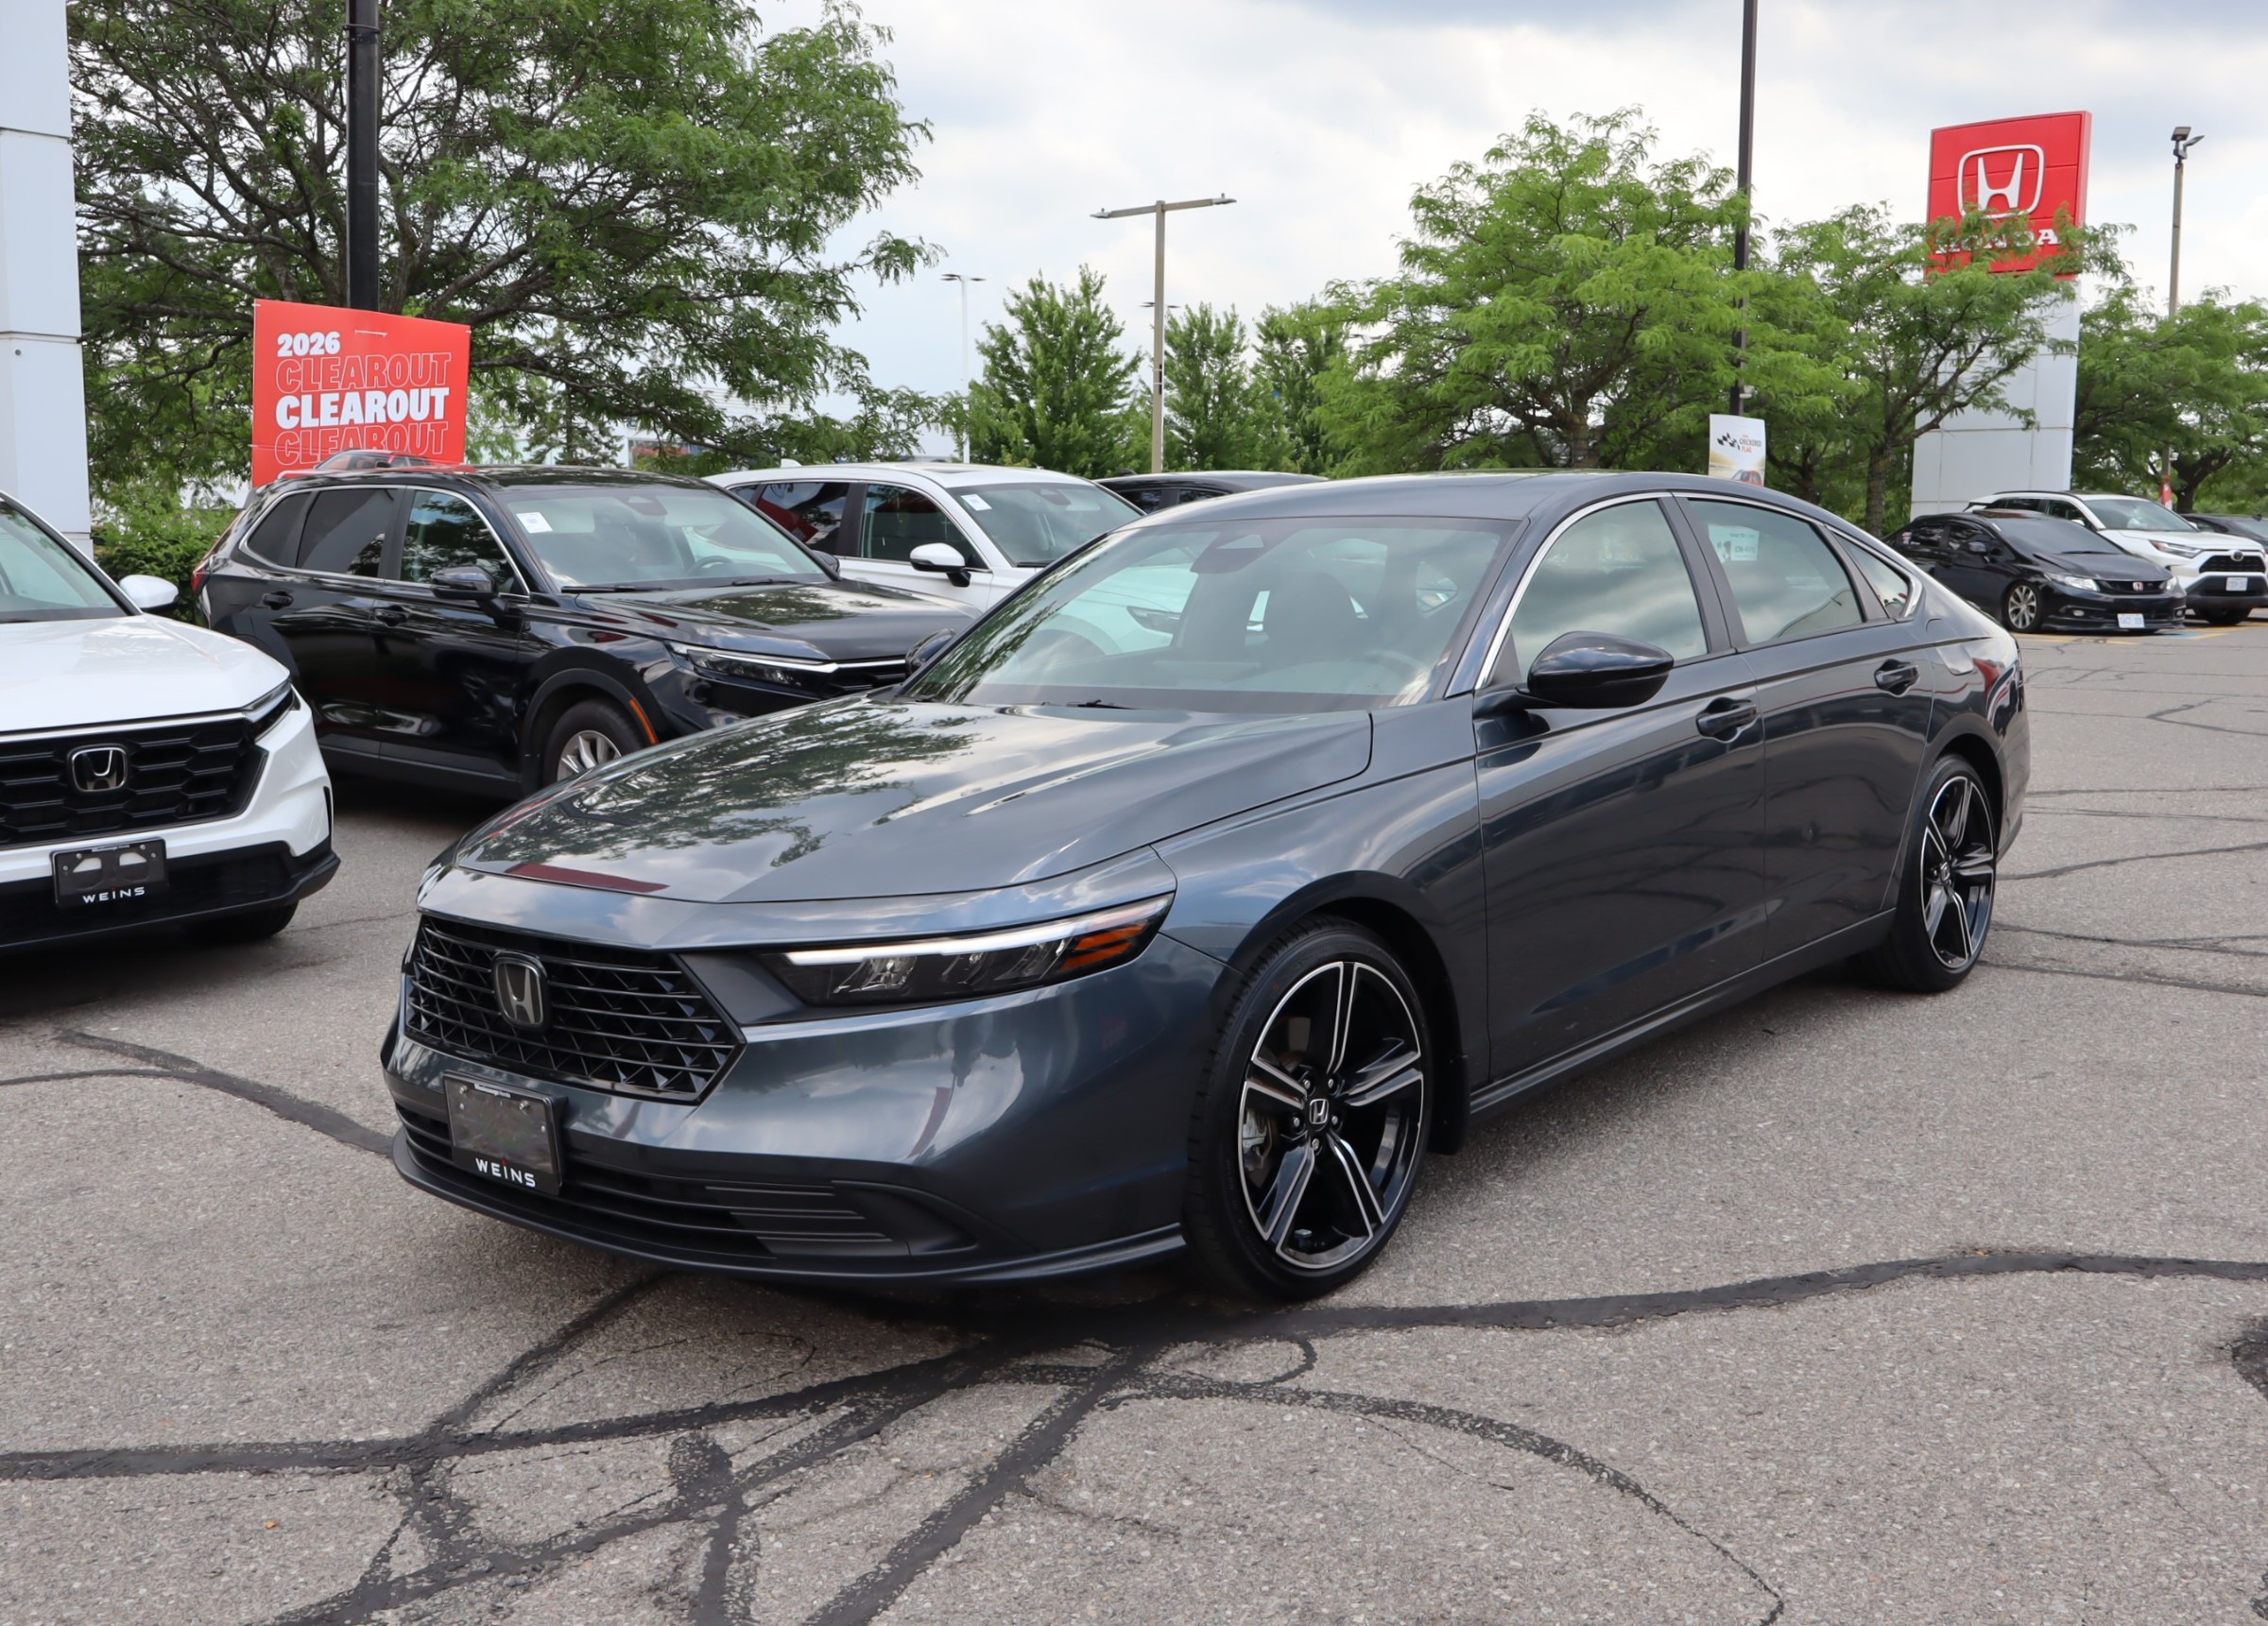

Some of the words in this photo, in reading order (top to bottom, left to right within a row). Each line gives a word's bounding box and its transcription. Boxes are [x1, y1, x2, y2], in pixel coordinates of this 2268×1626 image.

[277, 331, 340, 357] 2026
[276, 352, 452, 394] CLEAROUT
[275, 387, 450, 429] CLEAROUT
[82, 886, 146, 903] WEINS
[475, 1157, 536, 1188] WEINS
